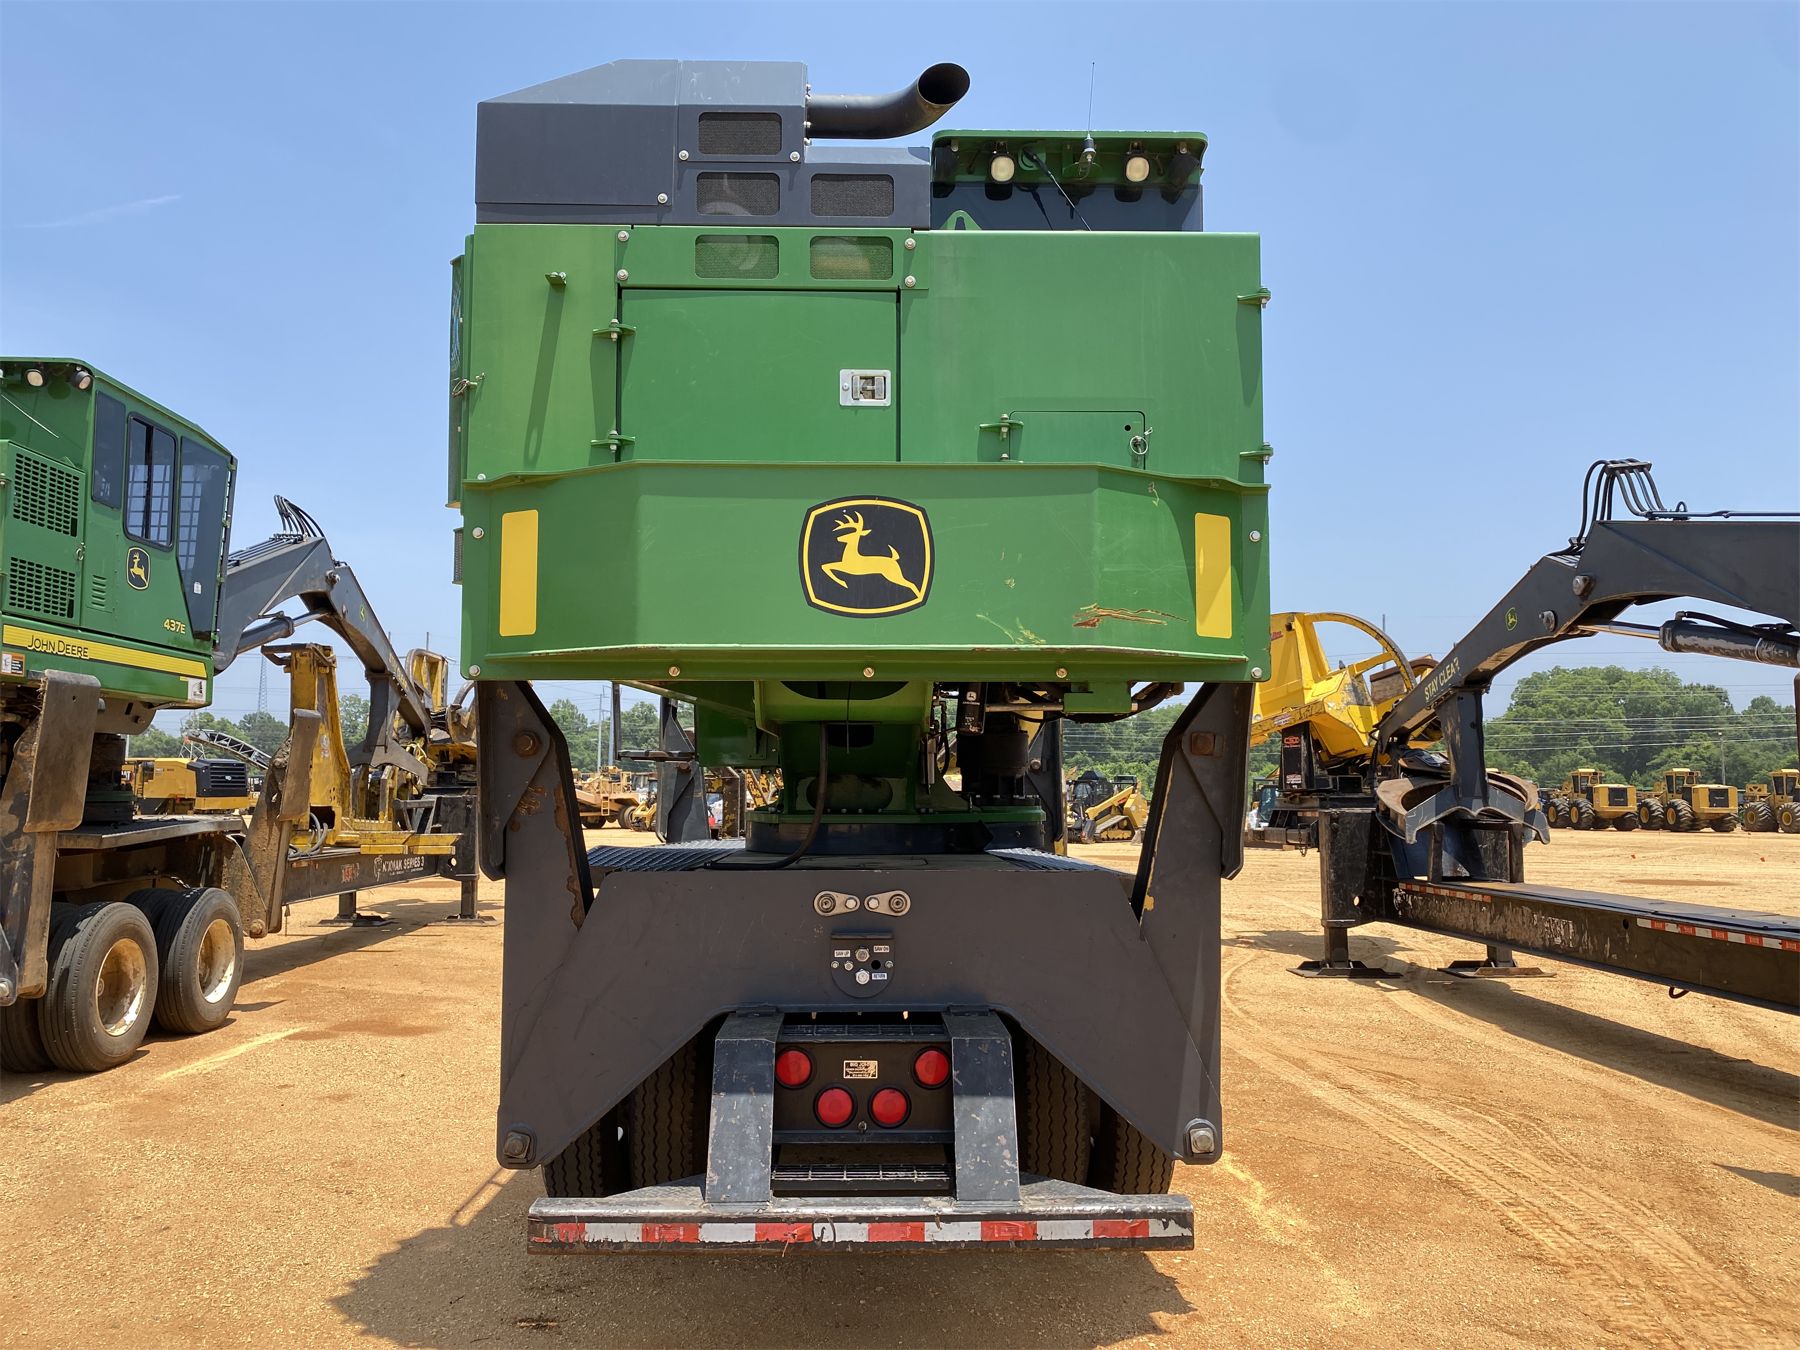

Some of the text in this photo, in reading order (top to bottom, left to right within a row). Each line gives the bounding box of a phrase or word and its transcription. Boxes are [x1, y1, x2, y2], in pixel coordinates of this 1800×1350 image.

[163, 618, 186, 634] 437E
[27, 634, 89, 658] JOHN DEERE
[1424, 656, 1460, 701] STAY CLEAR
[403, 856, 420, 870] SERIES
[420, 855, 425, 867] 3
